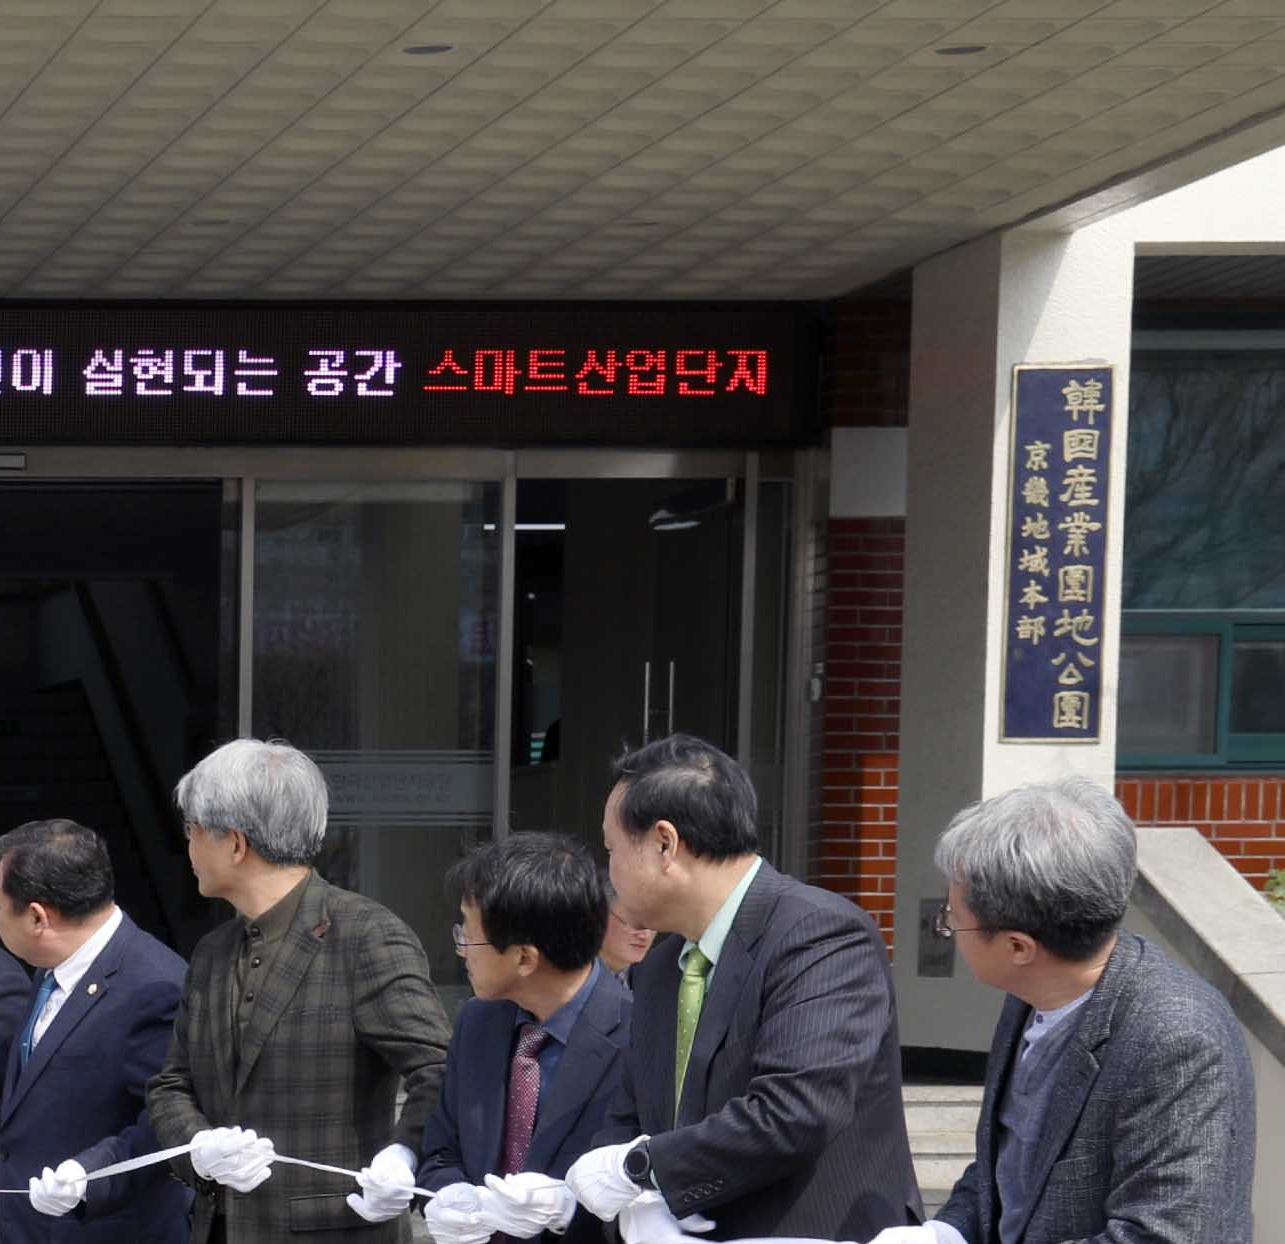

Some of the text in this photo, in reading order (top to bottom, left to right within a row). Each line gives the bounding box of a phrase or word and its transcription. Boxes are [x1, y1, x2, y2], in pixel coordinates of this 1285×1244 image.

[82, 349, 277, 395] 실현되는
[303, 350, 402, 396] 공간
[423, 350, 767, 395] 스마트산업단지
[1015, 440, 1052, 646] 京畿地域本部
